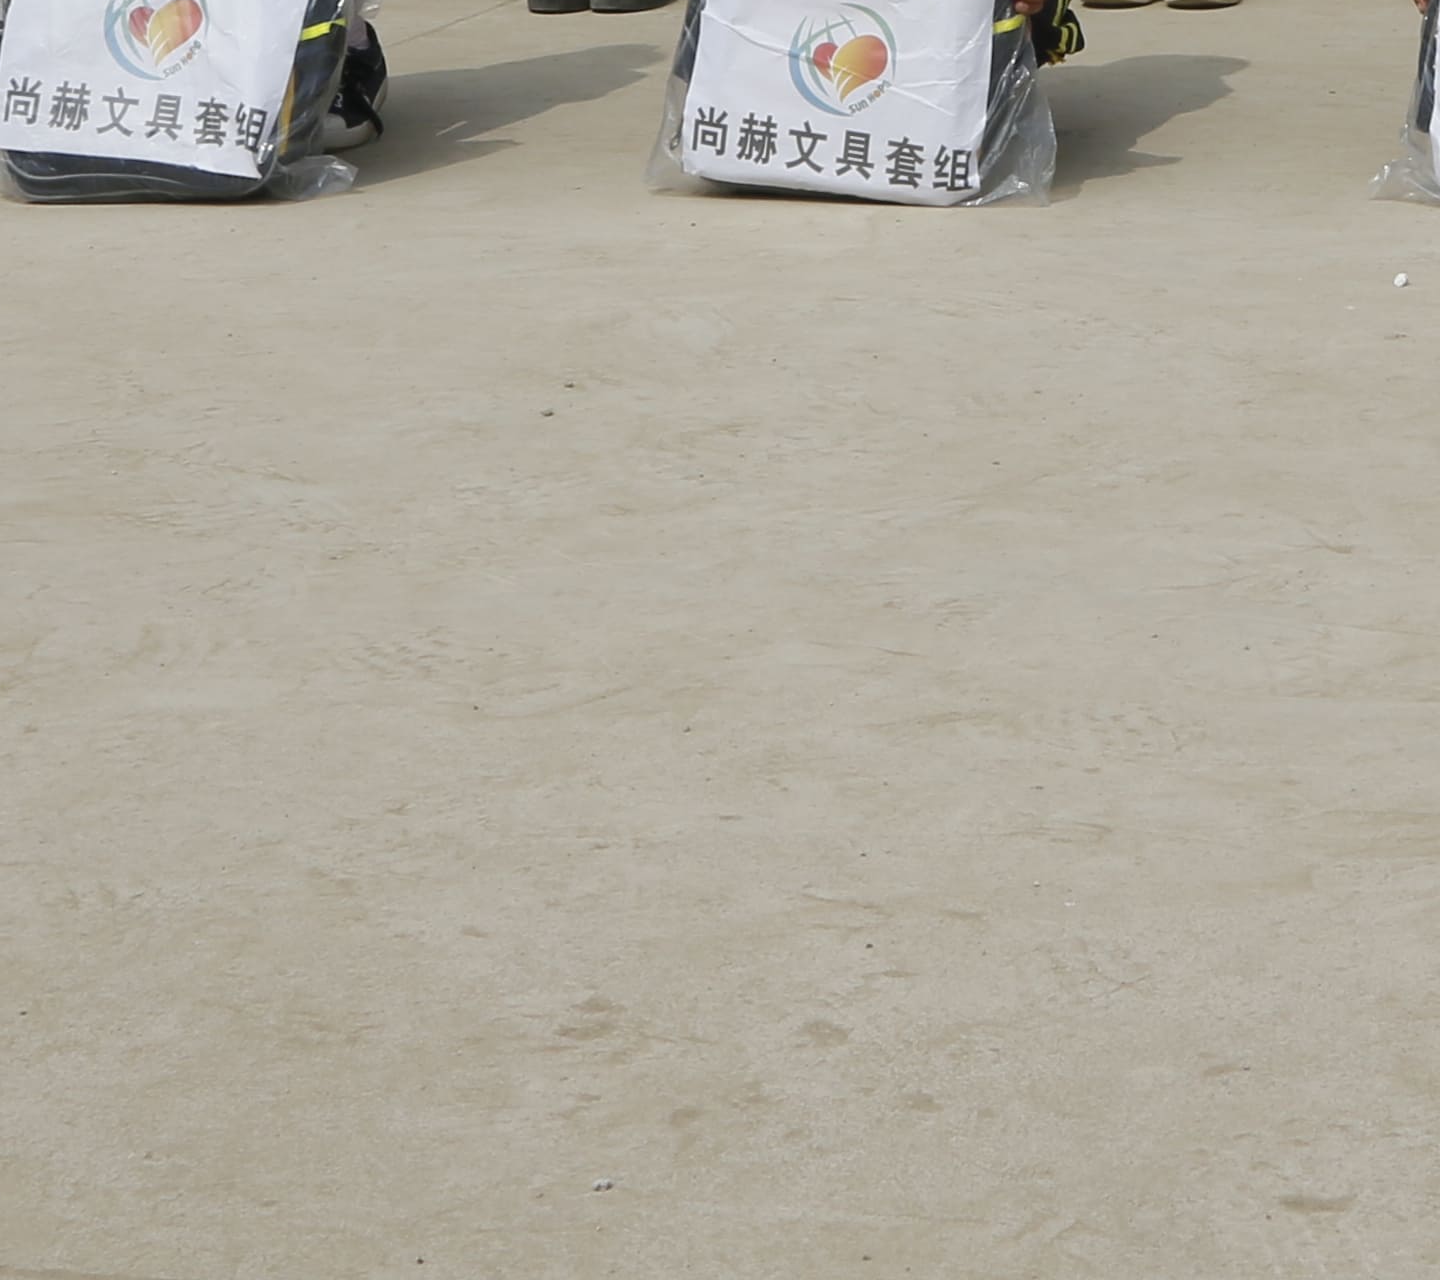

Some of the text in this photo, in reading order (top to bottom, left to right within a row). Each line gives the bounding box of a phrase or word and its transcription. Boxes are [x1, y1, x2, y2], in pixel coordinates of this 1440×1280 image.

[3, 76, 268, 153] 尚赫文具套组
[691, 106, 974, 192] 尚赫文具套组
